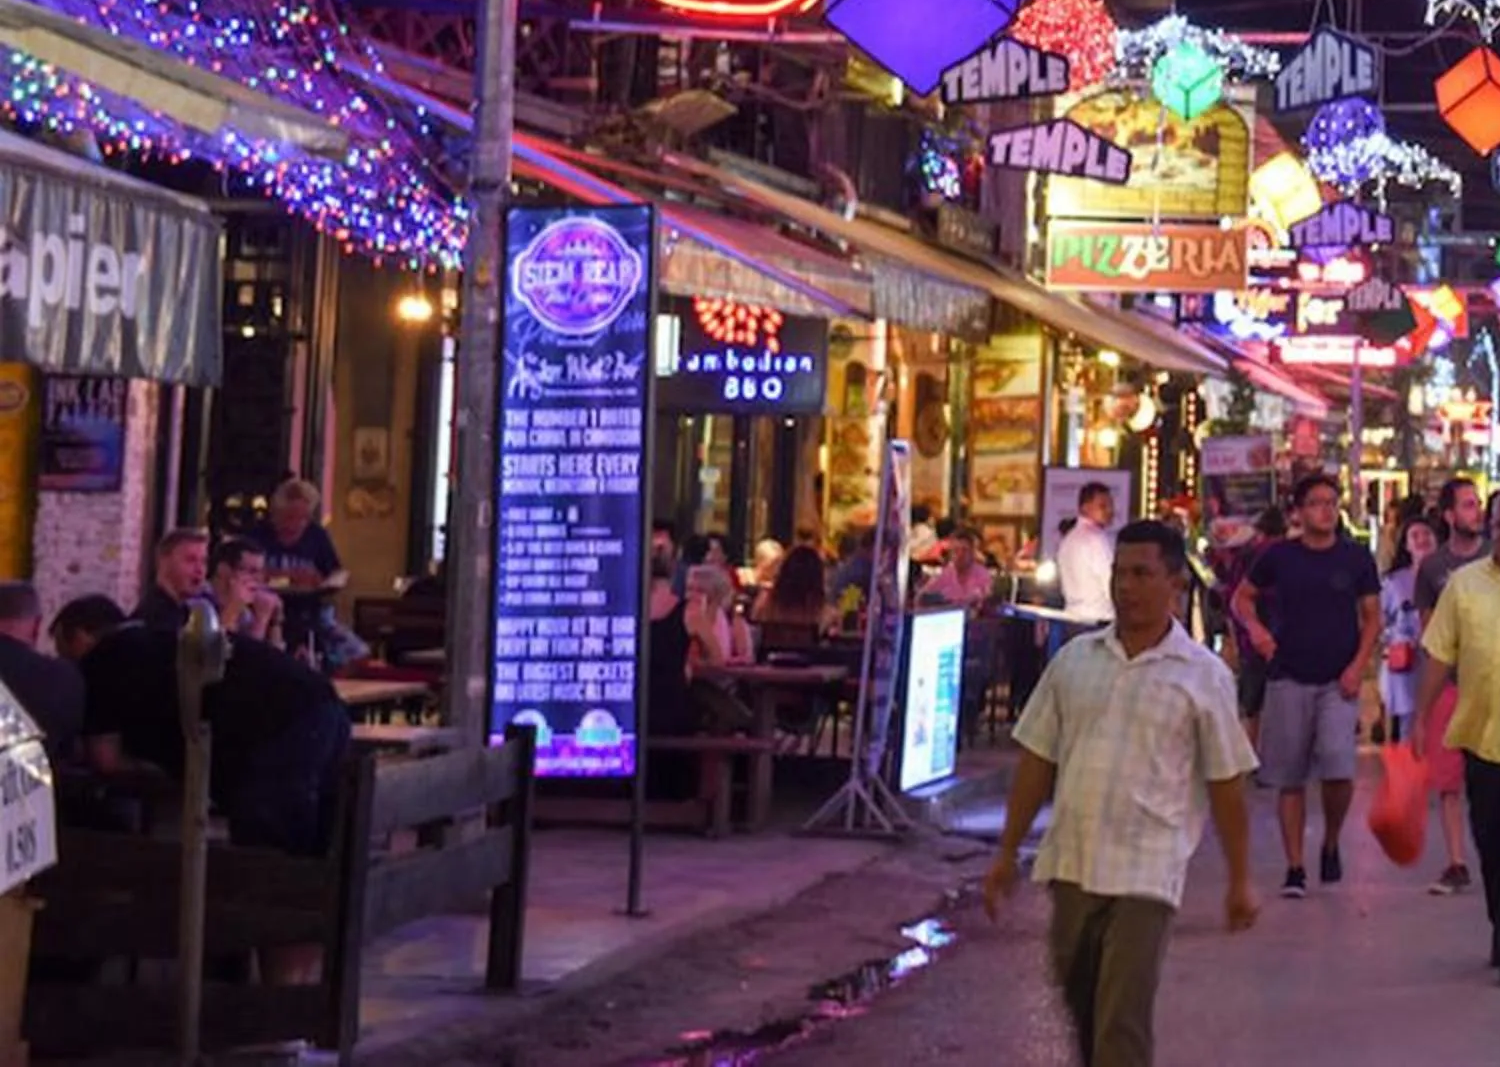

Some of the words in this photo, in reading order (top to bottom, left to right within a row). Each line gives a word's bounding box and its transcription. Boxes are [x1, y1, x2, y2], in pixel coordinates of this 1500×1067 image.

[944, 40, 1064, 101] TEMPLE
[1278, 30, 1374, 108] TEMPLE
[990, 122, 1128, 179] TEMPLE
[1292, 202, 1392, 243] TEMPLE
